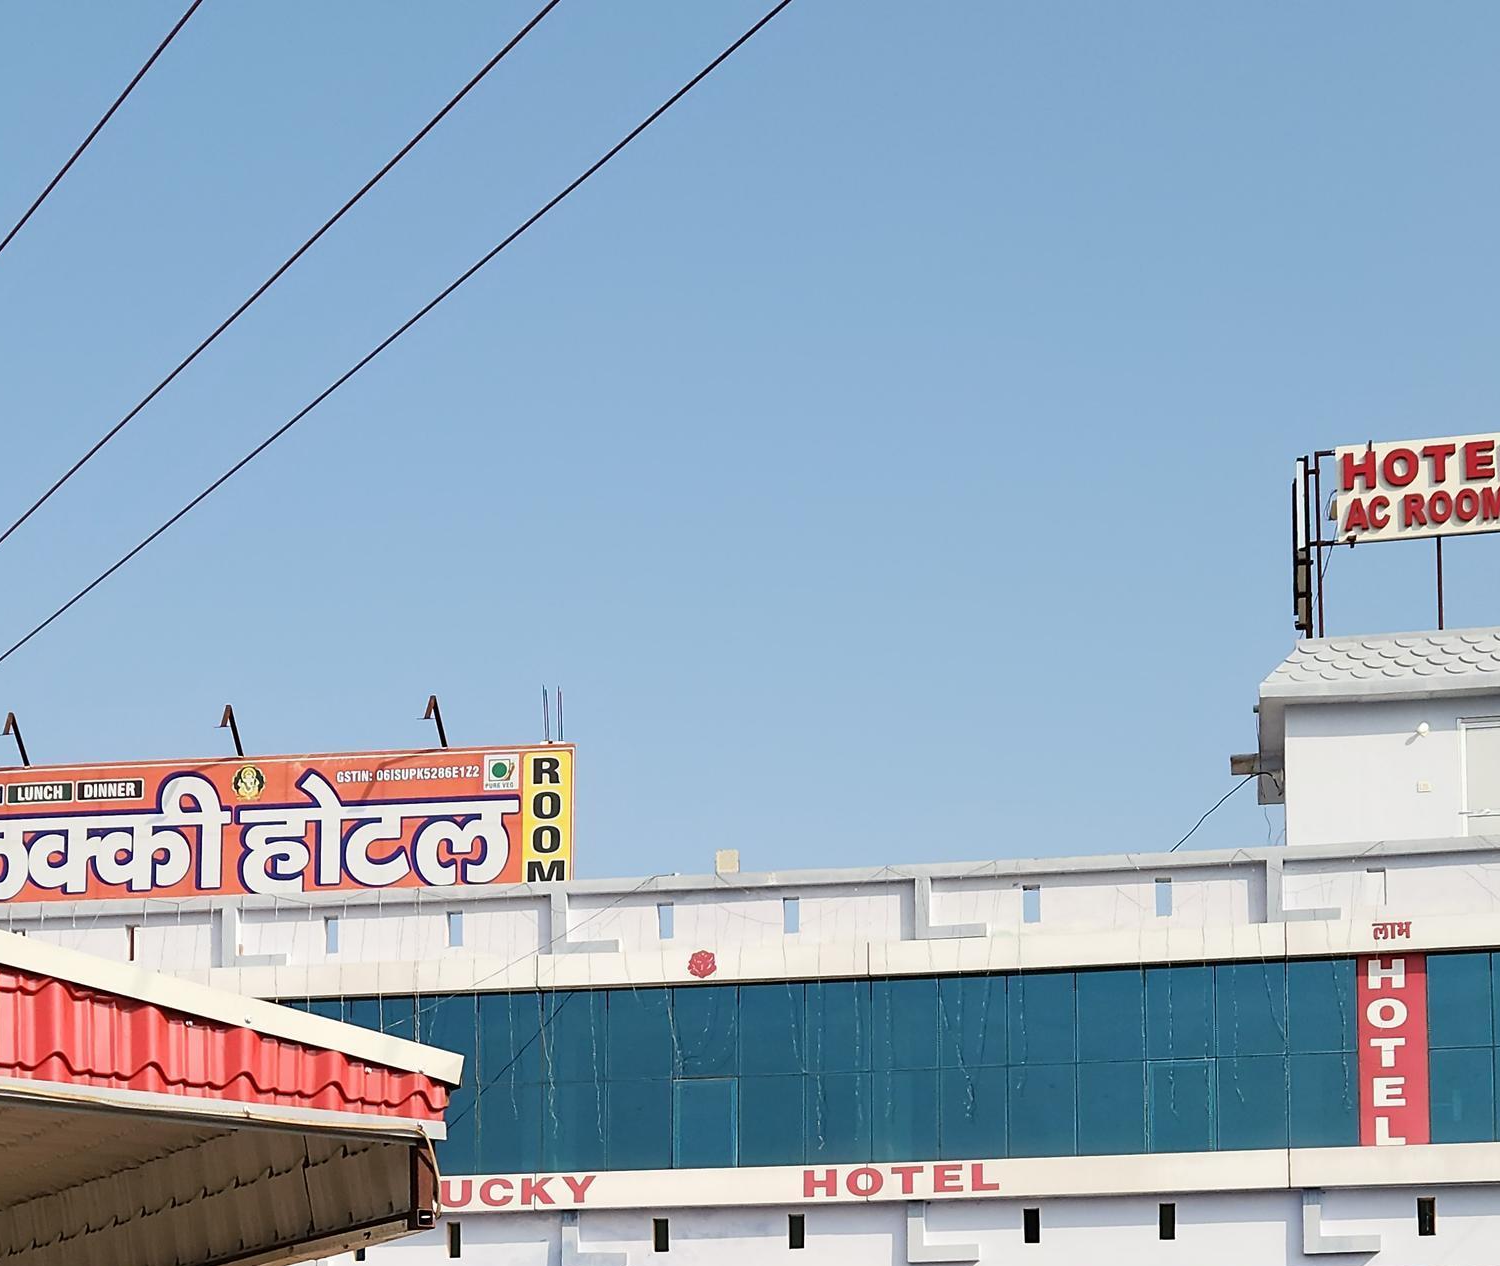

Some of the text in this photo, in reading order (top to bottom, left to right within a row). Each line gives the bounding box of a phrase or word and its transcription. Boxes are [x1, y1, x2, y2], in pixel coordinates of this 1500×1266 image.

[1345, 496, 1391, 533] AC
[17, 785, 63, 801] LUNCH
[84, 782, 136, 798] DINNER
[336, 769, 373, 783] GSTIN:
[238, 770, 520, 896] होटल
[527, 757, 565, 882] ROOM
[1372, 921, 1412, 940] लाभ
[1366, 958, 1409, 1146] HOTEL
[443, 1163, 1000, 1209] UCKY HOTEL
